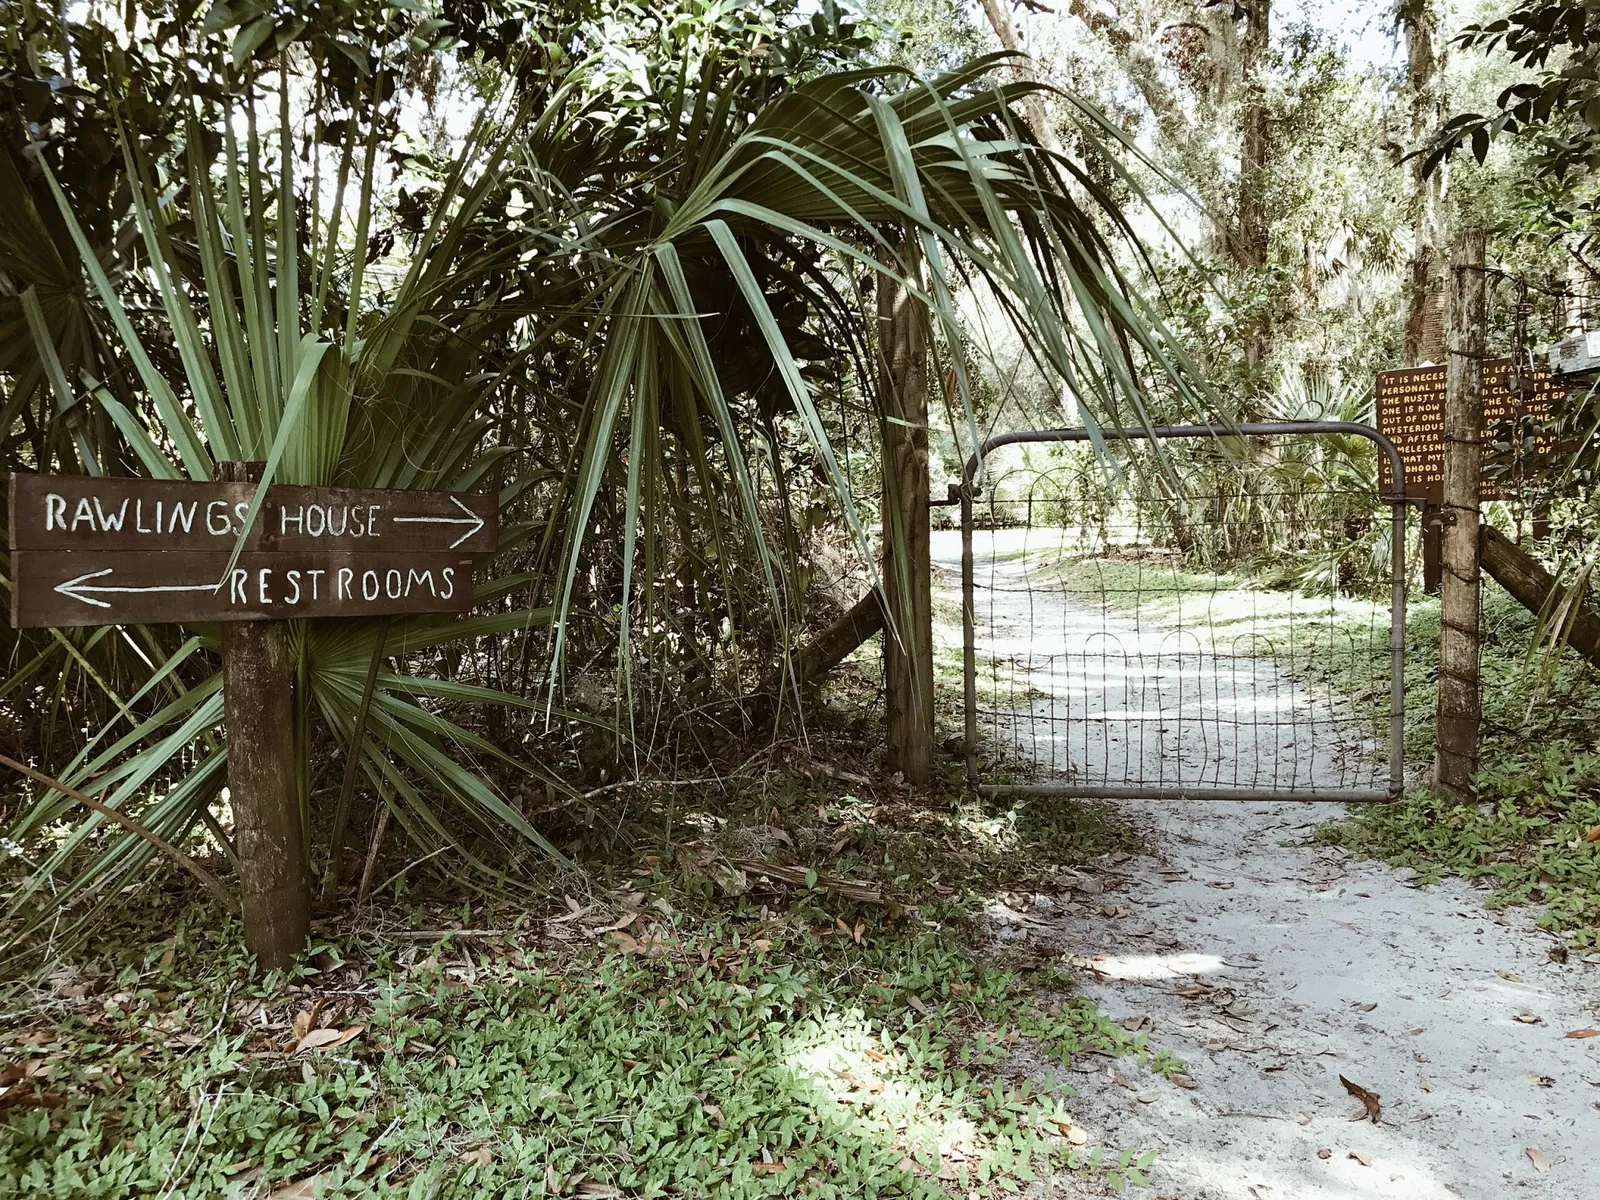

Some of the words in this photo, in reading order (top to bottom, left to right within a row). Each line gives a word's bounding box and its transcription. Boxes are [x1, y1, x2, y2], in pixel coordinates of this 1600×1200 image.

[1399, 375, 1409, 384] IS
[1381, 384, 1431, 396] PERSONAL
[1381, 397, 1400, 406] THE
[1403, 393, 1435, 404] RUSTY
[1381, 407, 1401, 416] ONE
[1404, 405, 1414, 414] IS
[1418, 403, 1440, 413] NOW
[1382, 416, 1401, 425] OUT
[1405, 415, 1418, 423] OF
[1421, 412, 1441, 422] ONE
[1483, 407, 1506, 417] AND
[1382, 422, 1445, 435] MYSTERIOUS
[1389, 436, 1403, 444] ND
[1407, 433, 1439, 443] AFTER
[1402, 453, 1422, 463] HAT
[1538, 446, 1552, 454] OF
[1413, 475, 1423, 483] IS
[46, 493, 250, 537] RAWLINGS
[281, 503, 381, 538] HOUSE
[230, 566, 455, 605] RESTROOMS
